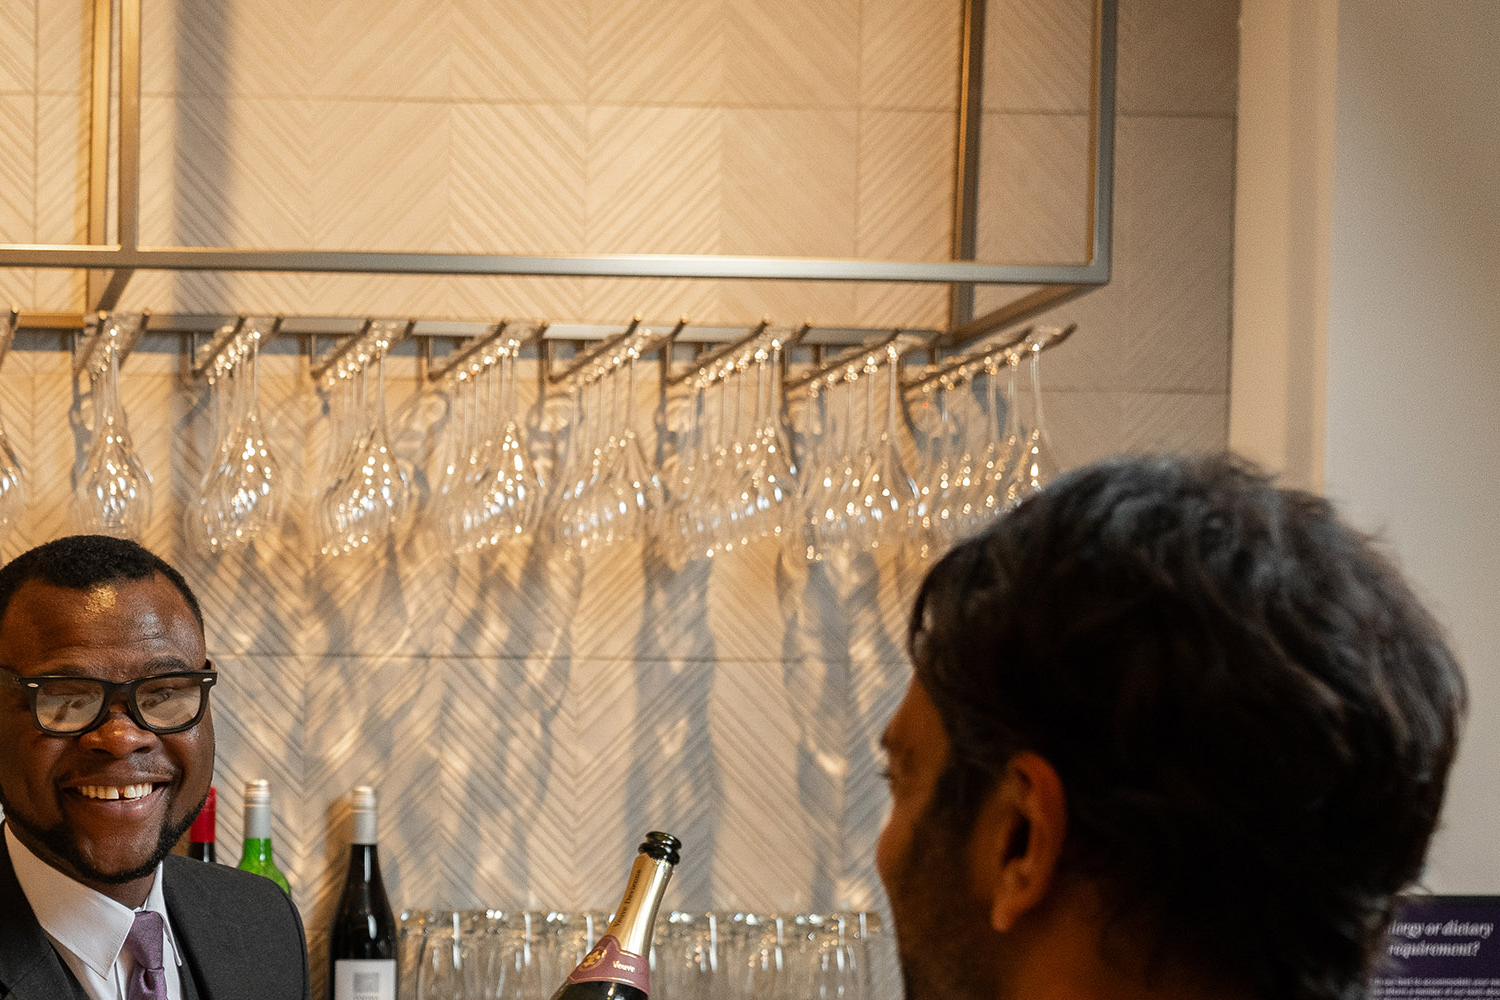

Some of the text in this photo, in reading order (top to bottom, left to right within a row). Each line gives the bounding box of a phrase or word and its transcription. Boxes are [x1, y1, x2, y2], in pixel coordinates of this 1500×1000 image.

[612, 868, 642, 928] Veuve Devienne
[1387, 919, 1494, 940] llergy or dietary
[1388, 940, 1481, 960] requirement?
[612, 959, 636, 974] Veuve
